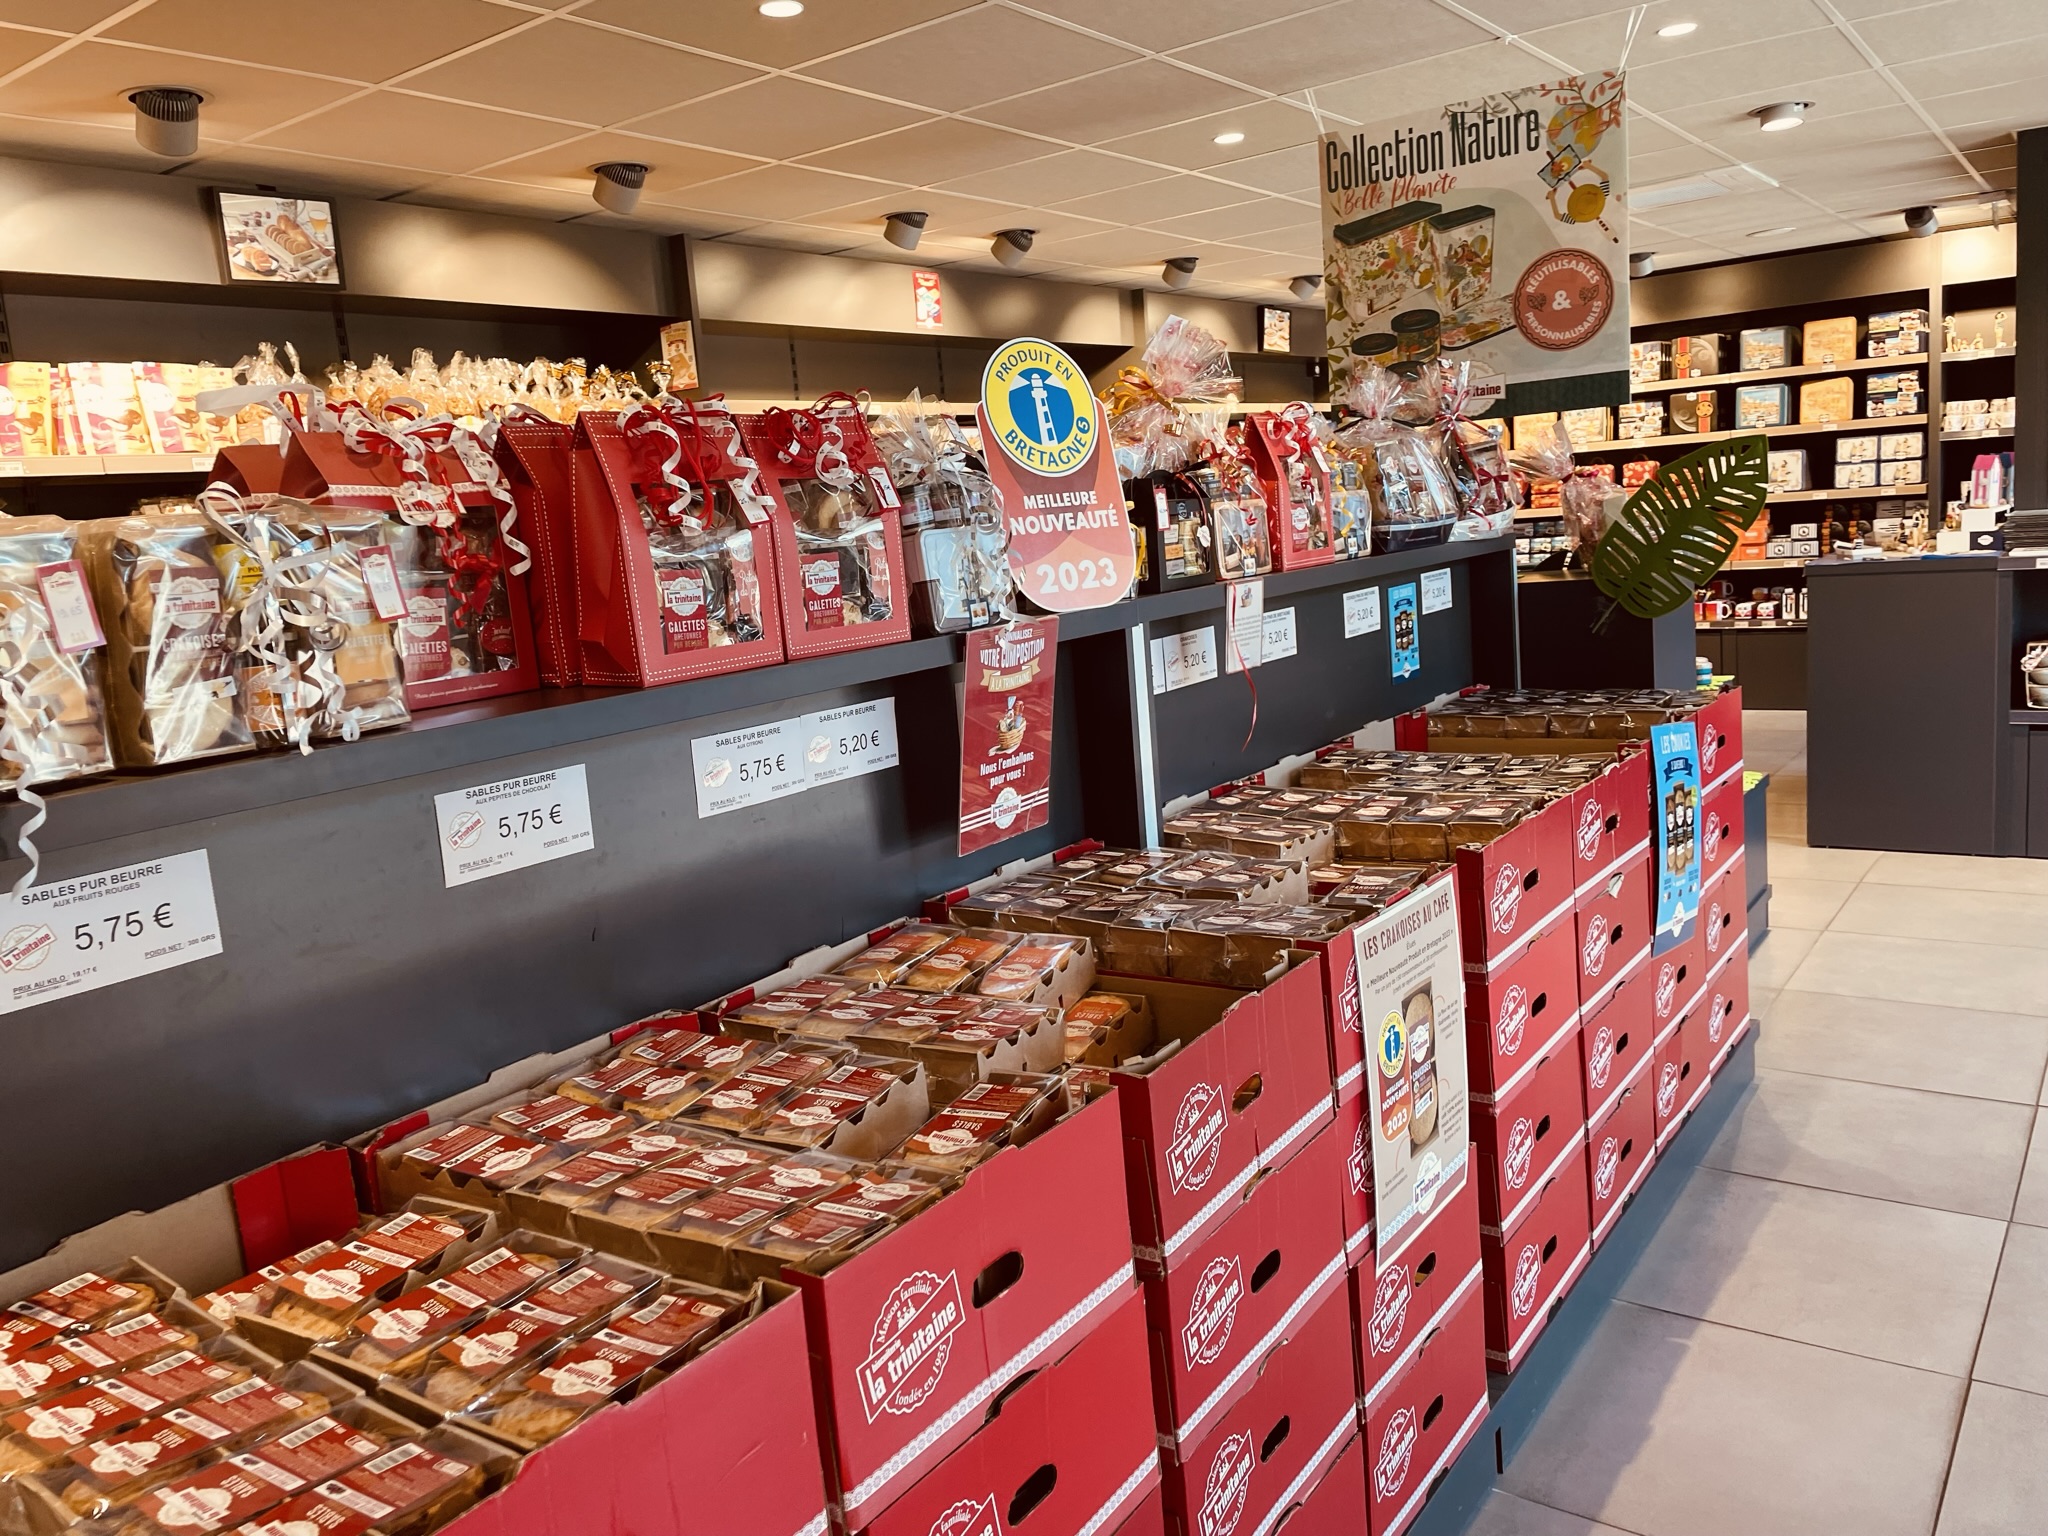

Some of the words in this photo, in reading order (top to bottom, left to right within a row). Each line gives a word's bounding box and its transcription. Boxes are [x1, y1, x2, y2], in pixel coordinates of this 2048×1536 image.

[1326, 127, 1444, 193] Collection
[1450, 110, 1540, 168] Nature
[1344, 180, 1385, 215] Belle
[1391, 173, 1458, 208] Planète
[1526, 259, 1600, 294] RÉUTILISABLES
[1552, 290, 1572, 310] &
[1525, 301, 1602, 340] PERSONNALISABLES
[996, 349, 1052, 382] PRODUIT
[1056, 361, 1073, 381] EN
[1004, 429, 1088, 468] BRETAGNE
[1023, 491, 1098, 510] MEILLEURE
[1010, 504, 1119, 536] NOUVEAUTÉ
[815, 574, 837, 584] trinitaine
[1036, 557, 1118, 594] 2023
[674, 590, 702, 603] trinitaine
[809, 598, 840, 611] GALETTES
[668, 618, 705, 632] GALETTES
[162, 634, 224, 652] CRAKOISE
[980, 648, 999, 667] VOTRE
[1001, 638, 1045, 668] COMPOSITION
[1184, 653, 1199, 669] 5,20
[819, 713, 842, 723] SABLES
[843, 710, 854, 718] PUR
[855, 705, 876, 716] BEURRE
[716, 735, 742, 748] SABLES
[743, 733, 755, 742] PUR
[757, 727, 781, 739] BEURRE
[840, 734, 868, 755] 5,20
[871, 730, 880, 747] €
[739, 757, 772, 782] 5,75
[776, 754, 786, 772] €
[980, 762, 997, 776] Nous
[998, 752, 1034, 770] l'emballons
[990, 774, 1006, 790] pour
[1006, 769, 1021, 781] vous
[466, 784, 501, 799] SABLES
[503, 780, 521, 791] PUR
[523, 772, 557, 787] BEURRE
[475, 797, 488, 805] AUX
[488, 792, 511, 803] PEPITES
[522, 783, 551, 795] CHOCOLAT
[499, 809, 543, 838] 5,75
[549, 804, 563, 824] €
[22, 885, 76, 905] SABLES
[80, 878, 107, 892] PUR
[111, 864, 163, 884] BEURRE
[53, 897, 71, 908] AUX
[73, 890, 103, 904] FRUITS
[105, 882, 141, 895] ROUGES
[74, 911, 144, 951] 5,75
[153, 903, 174, 928] €
[1363, 938, 1379, 960] LES
[1381, 910, 1422, 951] CRAKOISES
[1423, 904, 1432, 925] AU
[1434, 890, 1450, 917] CAFÉ
[13, 932, 52, 960] trinitaine
[13, 984, 31, 994] PRIX
[47, 976, 66, 984] KILO
[1177, 1104, 1190, 1135] Maison
[1387, 1108, 1408, 1136] 2023
[1171, 1153, 1184, 1180] la
[1184, 1109, 1222, 1166] trinitaine
[1194, 1279, 1207, 1311] Maison
[877, 1300, 900, 1343] Maison
[900, 1280, 932, 1300] familiale
[1187, 1330, 1198, 1357] la
[1200, 1279, 1239, 1341] trinitaine
[1372, 1322, 1380, 1344] la
[1380, 1284, 1408, 1332] trinitaine
[865, 1368, 886, 1405] la
[888, 1301, 956, 1383] trinitaine
[895, 1388, 923, 1405] fondée
[924, 1376, 934, 1390] en
[932, 1344, 947, 1374] 1955
[1386, 1426, 1414, 1475] trinitaine
[1214, 1453, 1250, 1520] trinitaine
